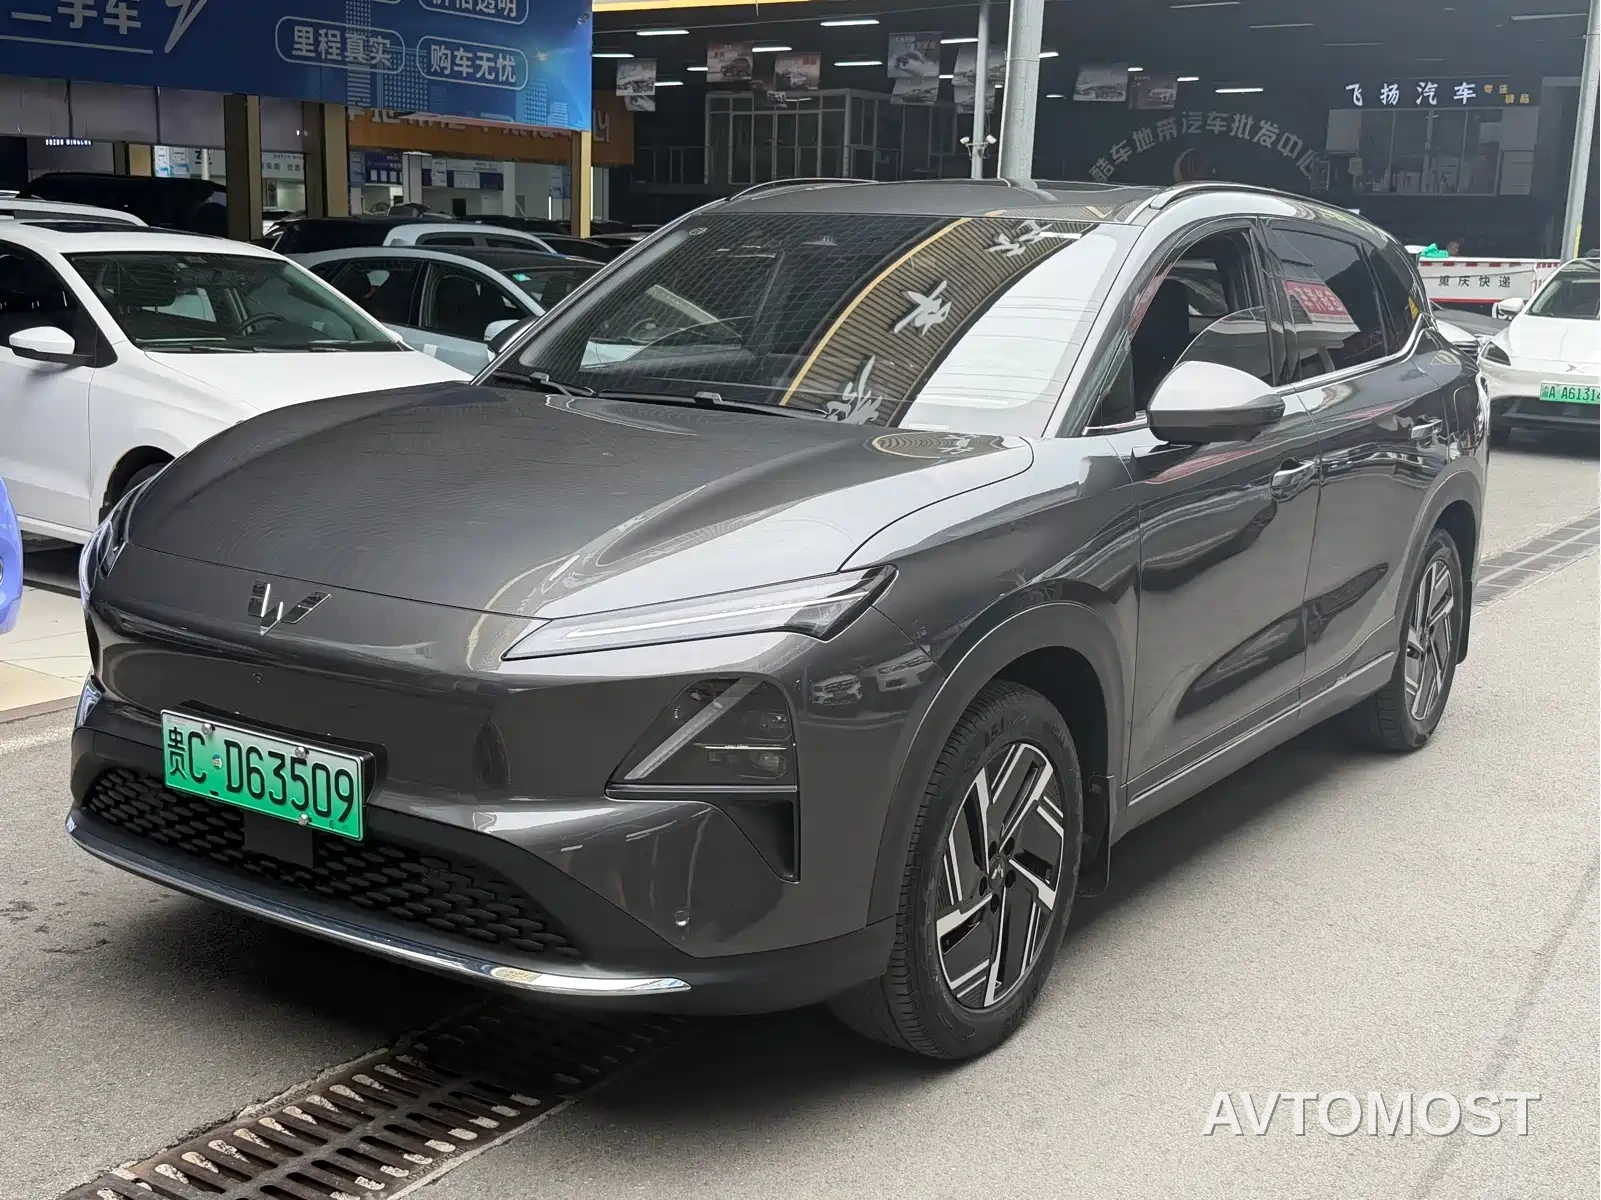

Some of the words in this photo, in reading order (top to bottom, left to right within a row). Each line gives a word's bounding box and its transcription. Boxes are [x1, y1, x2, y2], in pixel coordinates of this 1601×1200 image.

[291, 25, 392, 67] 里程真实
[430, 44, 517, 84] 购车无忧
[1345, 81, 1477, 107] 飞扬汽车
